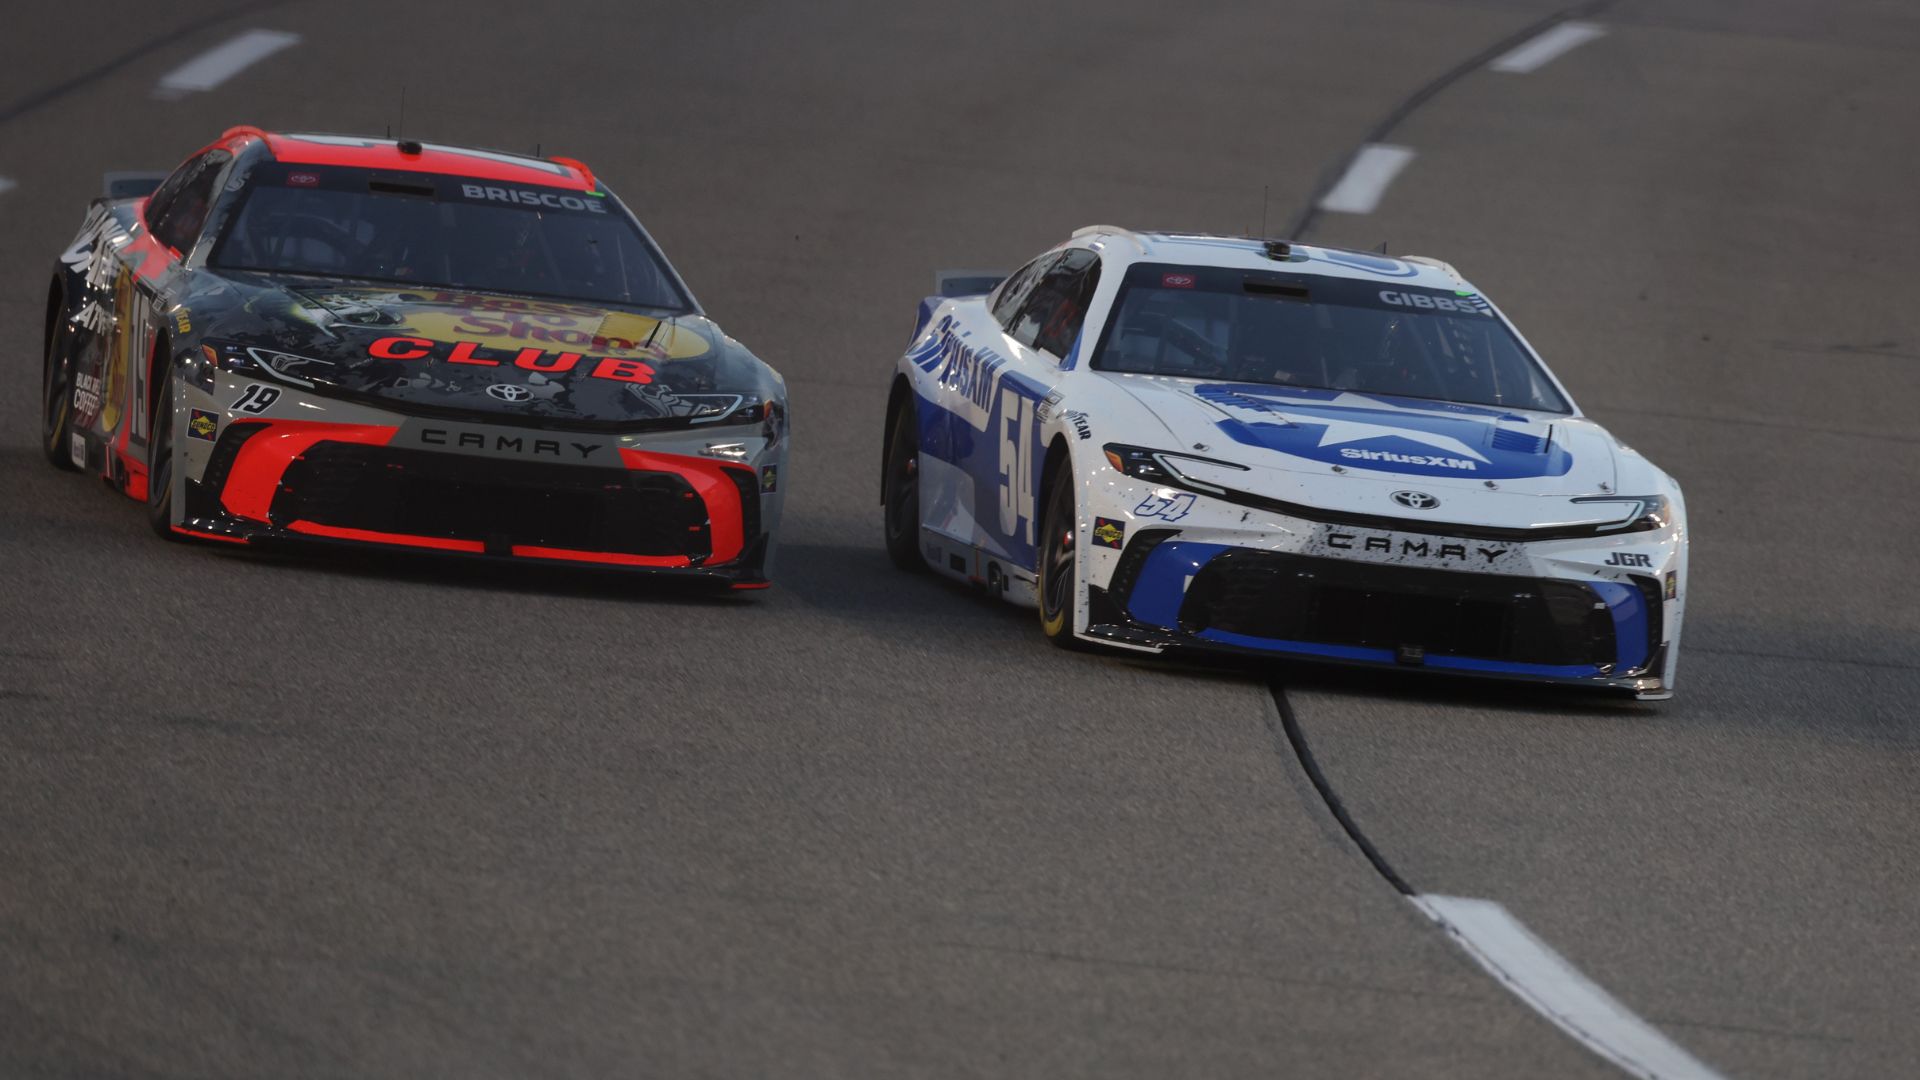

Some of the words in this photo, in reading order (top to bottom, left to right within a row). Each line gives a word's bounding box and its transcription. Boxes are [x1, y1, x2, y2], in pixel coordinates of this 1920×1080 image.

[461, 183, 607, 214] BRISCOE
[1379, 290, 1478, 314] GIBBS
[368, 337, 656, 385] CLUB
[229, 383, 281, 415] 19
[420, 428, 603, 459] CAMRY
[998, 388, 1035, 547] 54
[1339, 448, 1477, 471] SiriusXM
[1133, 492, 1198, 522] 54
[1327, 533, 1508, 564] CAMRY
[1604, 551, 1653, 568] JGR
